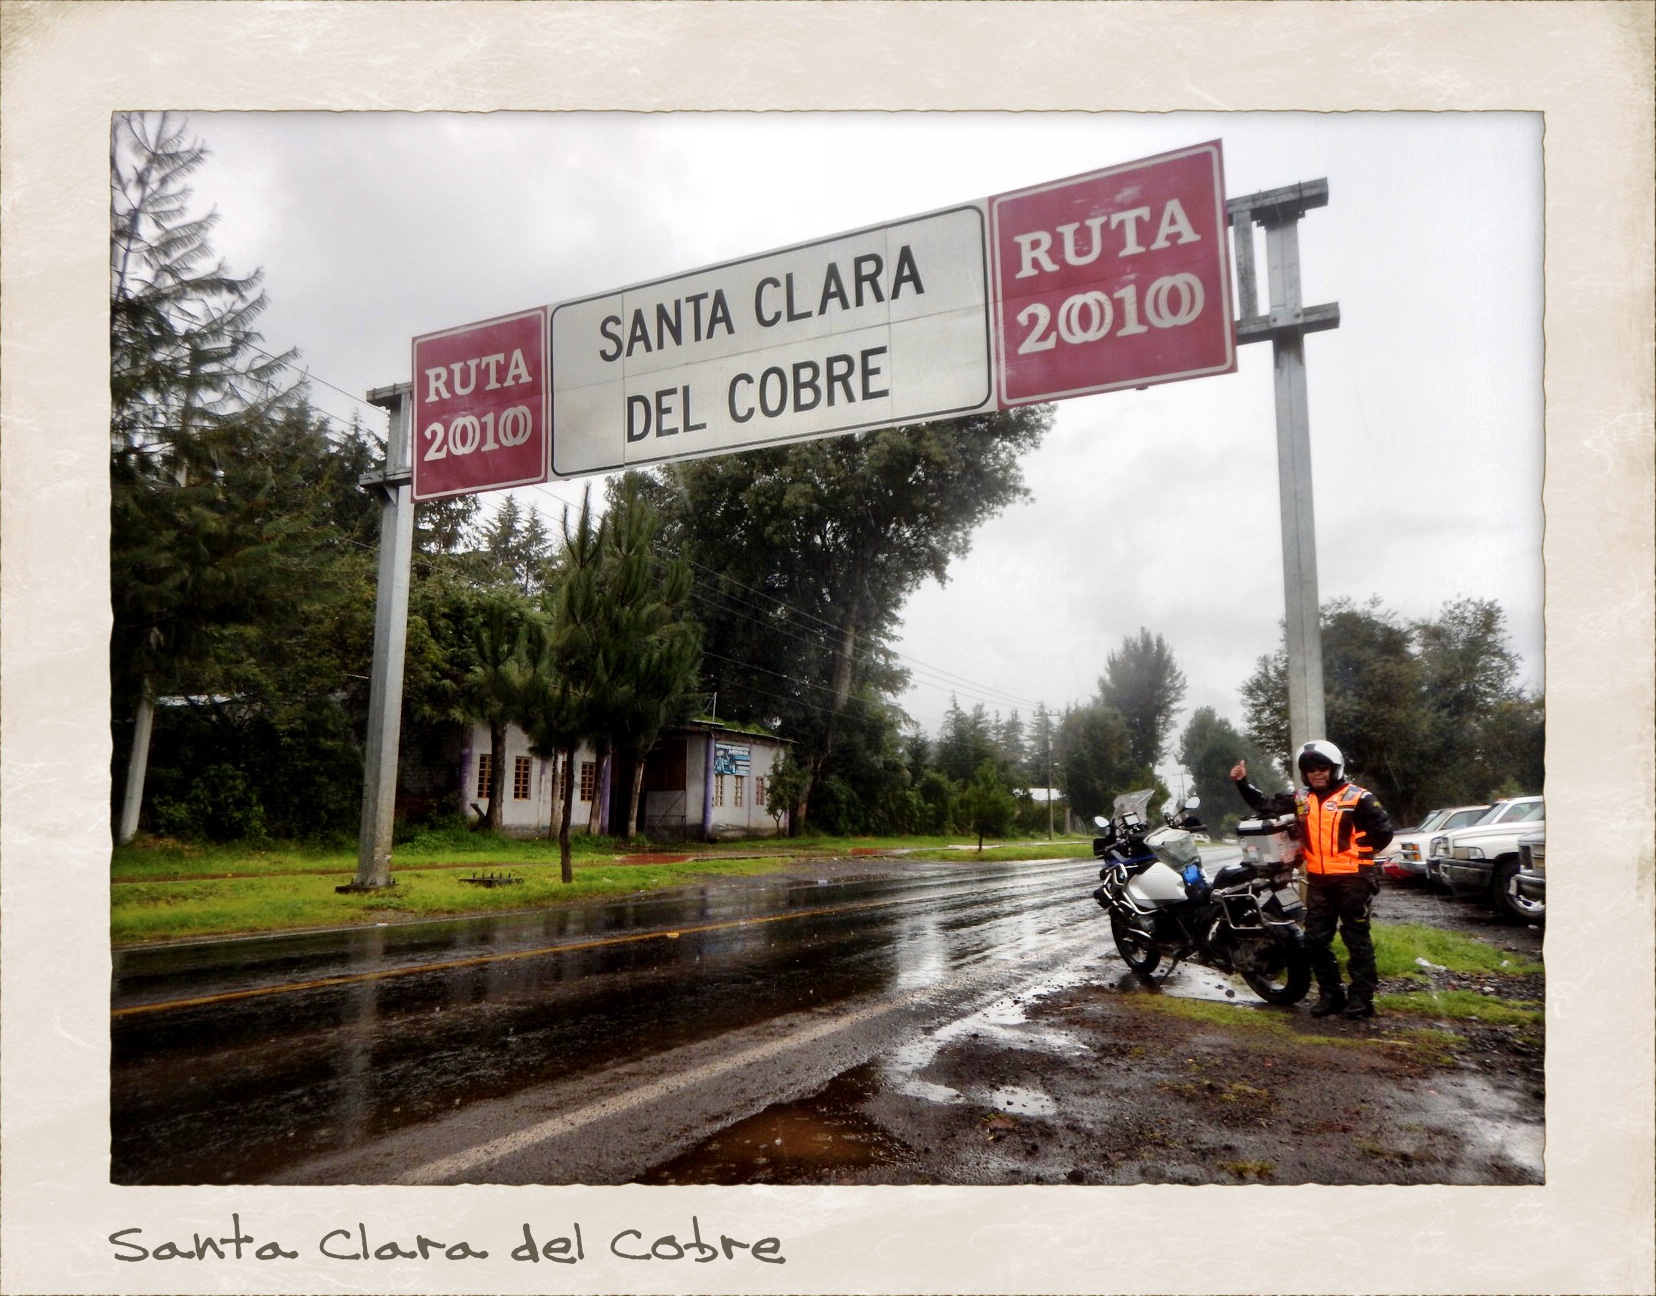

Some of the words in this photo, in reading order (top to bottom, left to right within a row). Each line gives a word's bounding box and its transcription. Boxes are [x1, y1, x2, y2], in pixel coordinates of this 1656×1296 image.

[1013, 198, 1201, 279] RUTA
[599, 289, 735, 362] SANTA
[755, 245, 925, 327] CLARA
[1016, 272, 1205, 355] 2010
[425, 348, 532, 403] RUTA
[627, 384, 707, 443] DEL
[728, 345, 890, 423] COBRE
[424, 405, 532, 461] 2010
